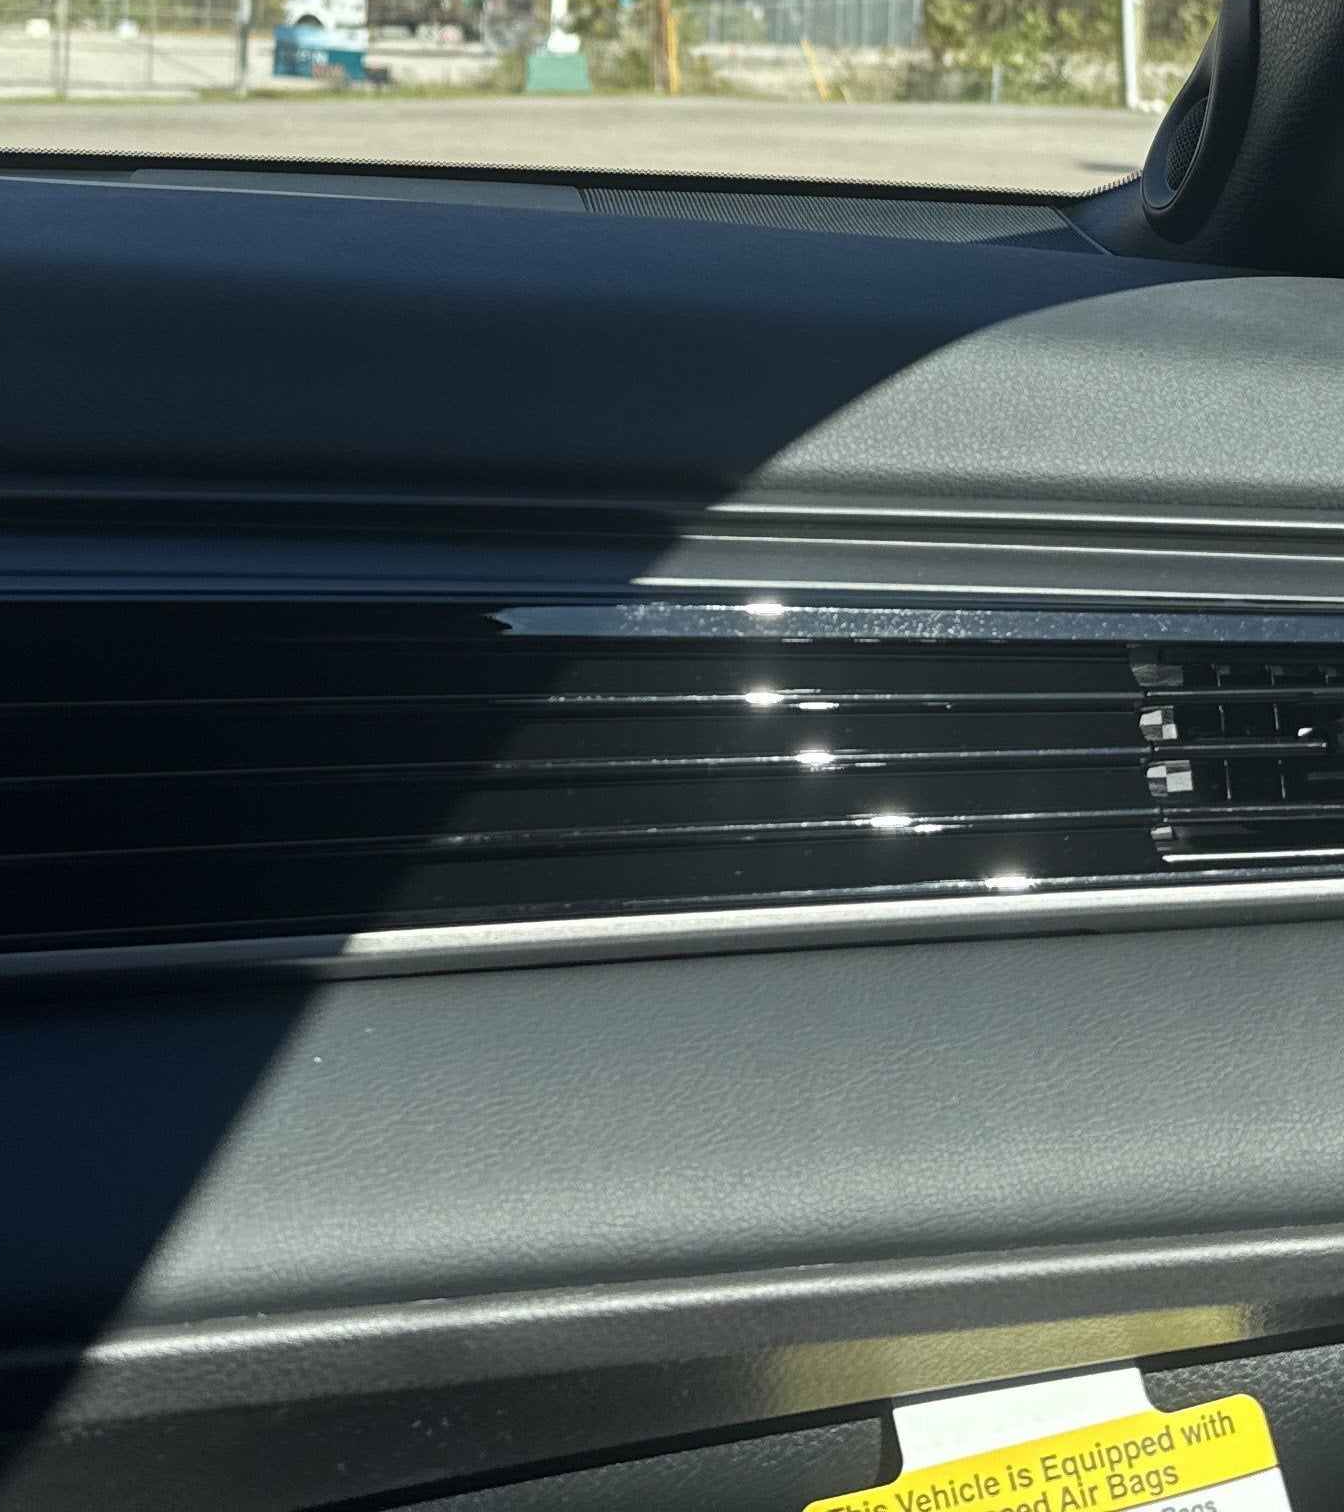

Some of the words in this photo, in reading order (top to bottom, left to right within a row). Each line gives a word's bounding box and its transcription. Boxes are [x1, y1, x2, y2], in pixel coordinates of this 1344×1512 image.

[895, 1473, 1000, 1512] Vehicle
[1006, 1464, 1034, 1492] is
[1039, 1424, 1175, 1488] Equipped
[1180, 1410, 1236, 1447] with
[1059, 1485, 1098, 1512] Air
[1106, 1465, 1179, 1501] Bags
